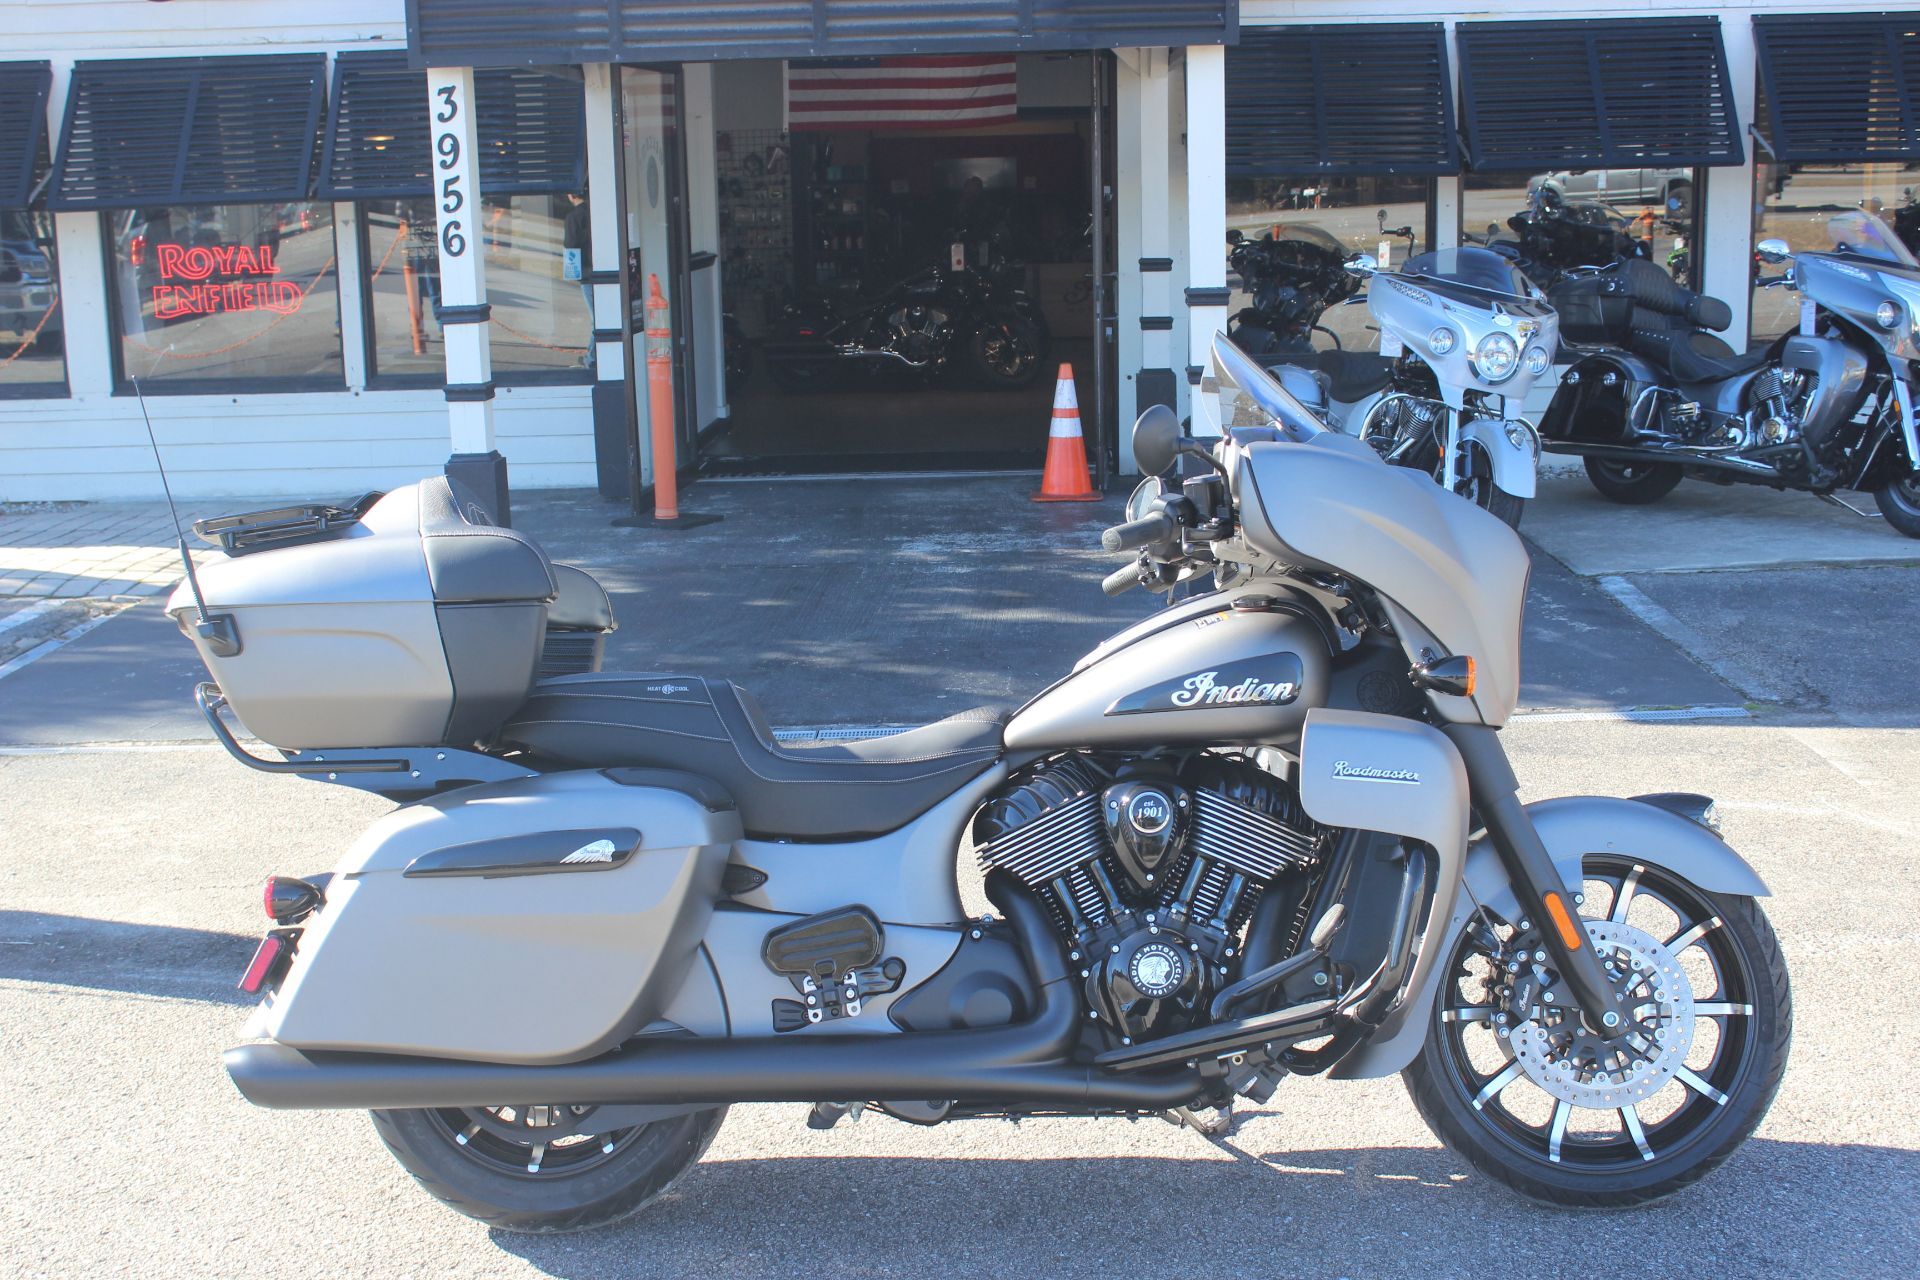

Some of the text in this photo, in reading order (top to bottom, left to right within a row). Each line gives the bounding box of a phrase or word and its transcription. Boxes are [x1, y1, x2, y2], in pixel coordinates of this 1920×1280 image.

[437, 85, 466, 257] 3956
[157, 244, 281, 280] ROYAL
[153, 281, 303, 319] ENFIELD
[1171, 671, 1293, 707] Indian
[1333, 760, 1420, 780] Roadmaster
[1137, 806, 1163, 818] 1901
[1131, 944, 1182, 987] INDIAN MOTORCYCLE
